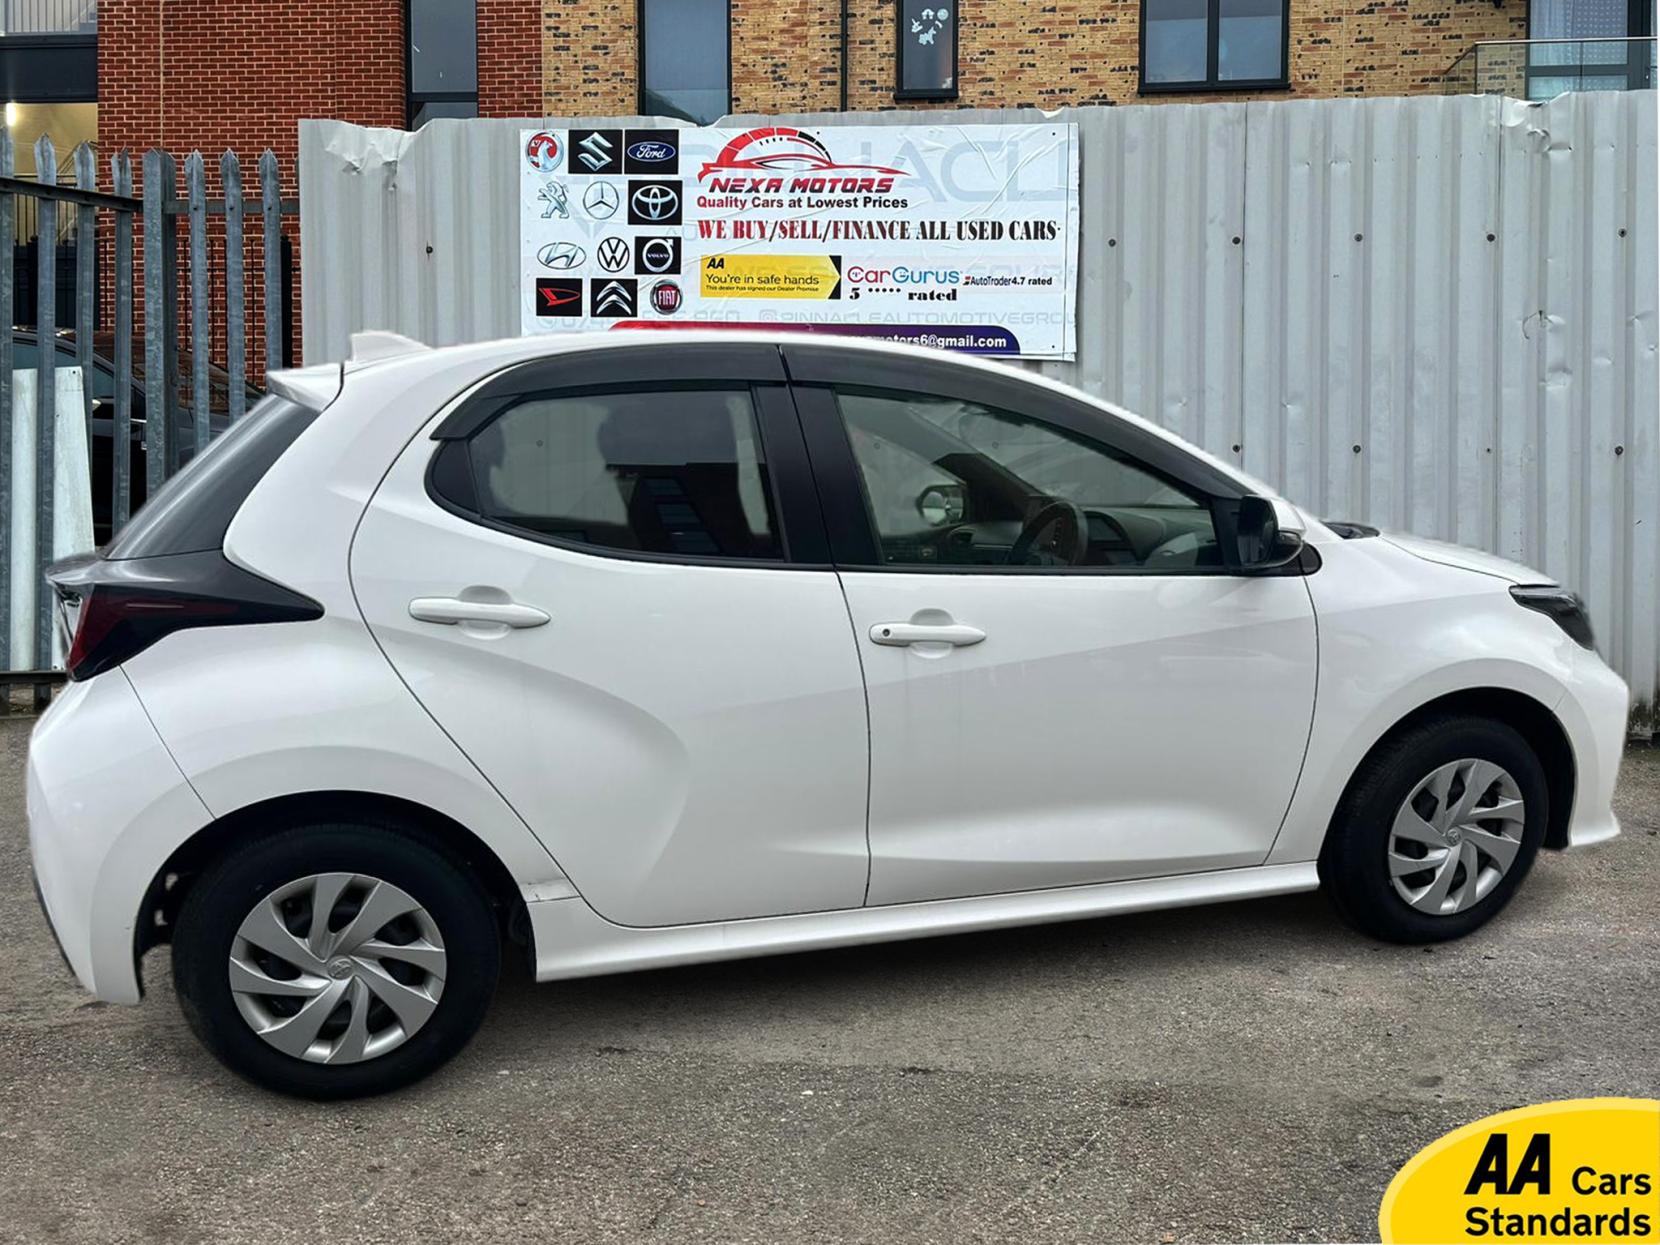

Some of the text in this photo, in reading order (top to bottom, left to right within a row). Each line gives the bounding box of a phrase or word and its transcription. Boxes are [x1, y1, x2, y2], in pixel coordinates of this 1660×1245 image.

[636, 145, 666, 158] Ford
[708, 178, 895, 193] NEXA MOTORS
[697, 196, 908, 210] Quality Cars at Lowest Prices
[698, 220, 727, 239] WE
[733, 220, 911, 242] BUY/SELL/FINANCE
[916, 221, 950, 240] ALL
[956, 221, 1003, 240] USED
[1009, 221, 1057, 240] CARS
[706, 257, 725, 269] AA
[705, 273, 820, 285] You're in safe hands
[847, 266, 960, 284] CarGurus
[1028, 277, 1053, 285] rated
[658, 290, 677, 305] FIAT
[849, 287, 957, 300] 5 rated
